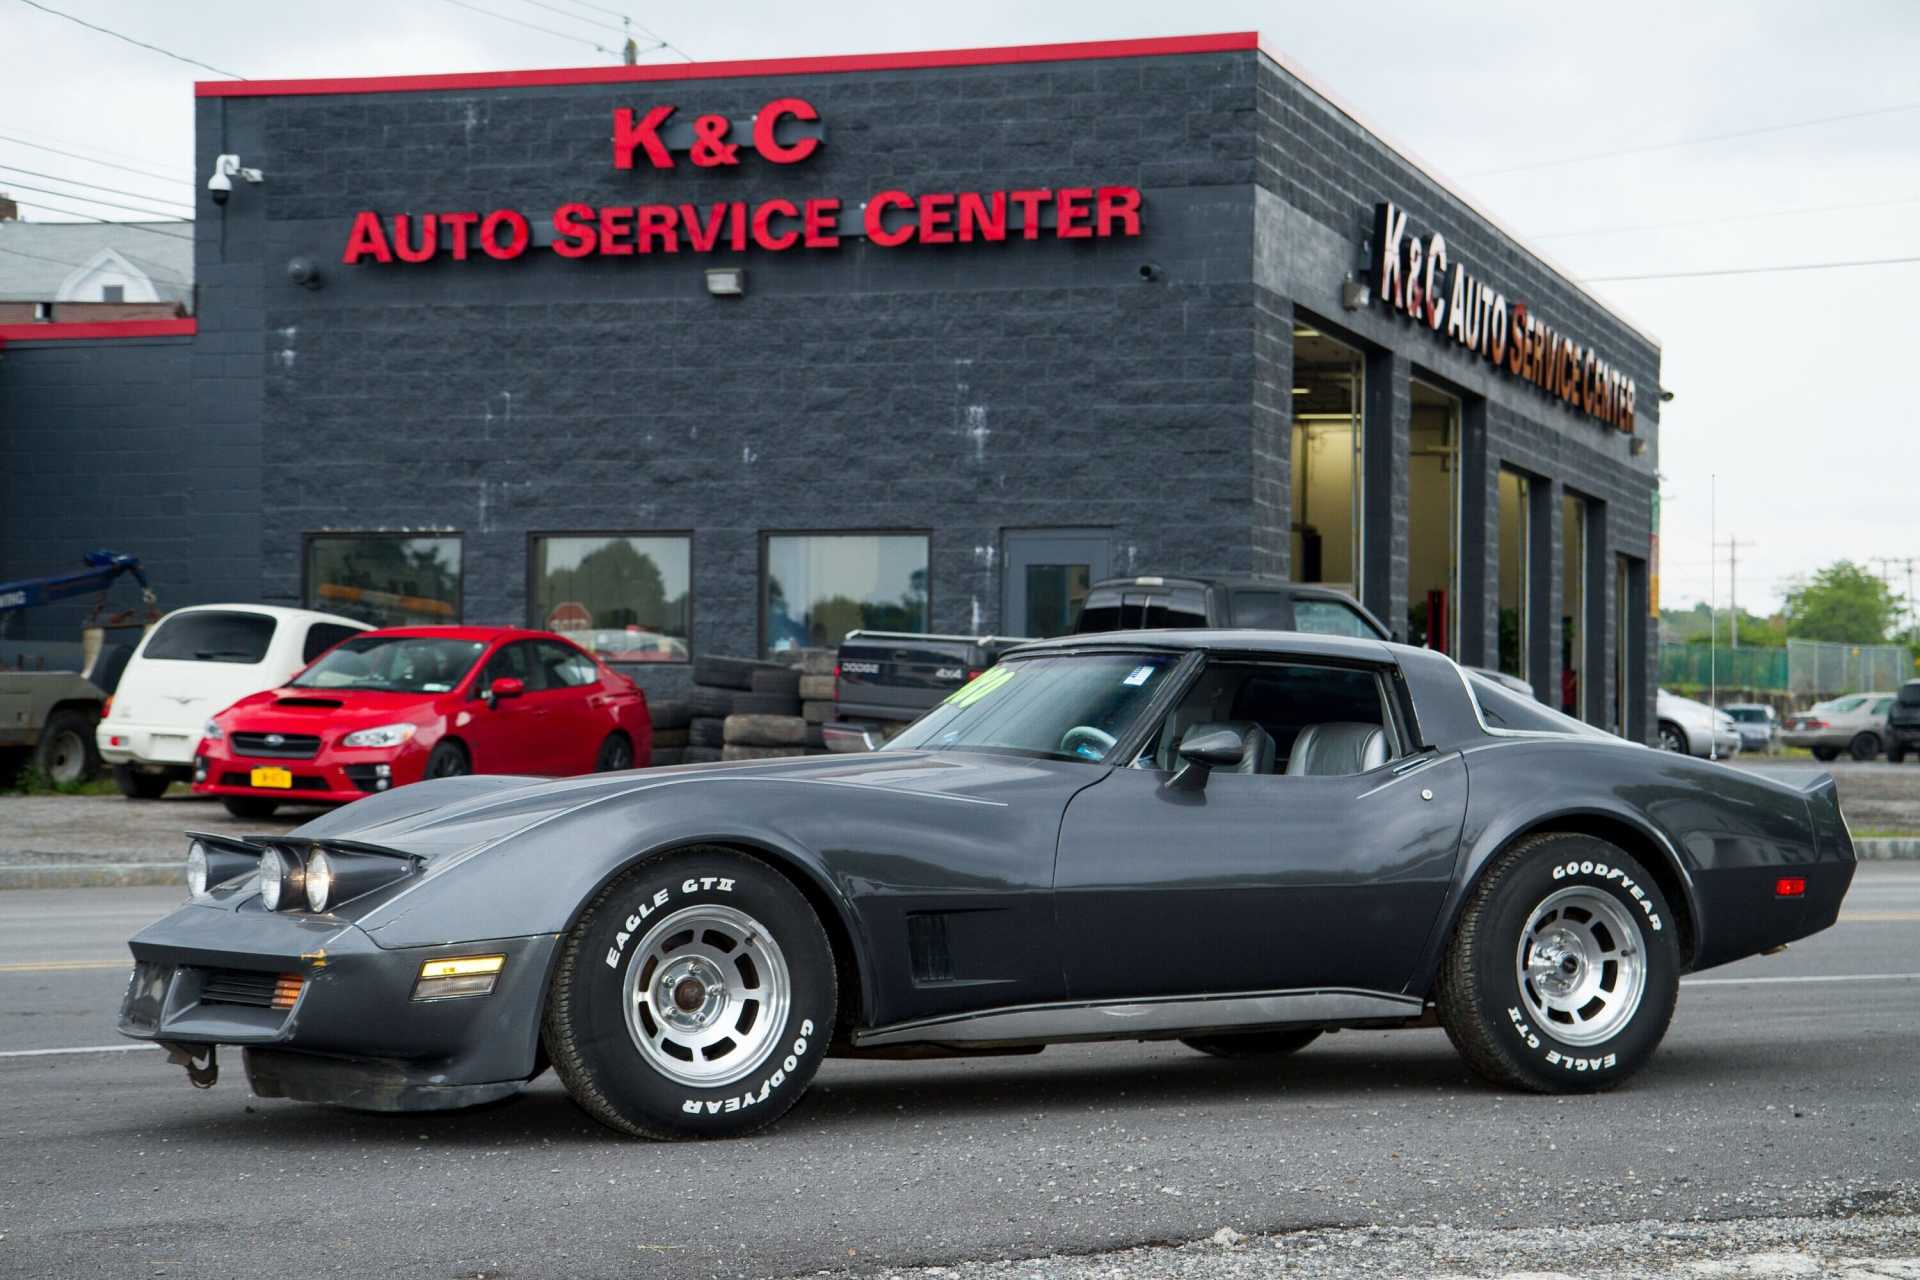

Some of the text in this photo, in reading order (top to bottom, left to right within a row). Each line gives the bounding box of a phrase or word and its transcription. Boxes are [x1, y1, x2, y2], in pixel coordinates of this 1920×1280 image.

[612, 97, 824, 170] K & C
[342, 185, 1142, 265] AUTO SERVICE CENTER
[1447, 262, 1508, 366] AUTO
[1509, 302, 1582, 408] SERVICE
[1583, 346, 1637, 433] CENTER
[842, 662, 880, 674] DODGE
[605, 887, 670, 969] EAGLE
[1552, 860, 1663, 931] GOODYEAR
[681, 1018, 815, 1115] GOODYEAR
[1545, 1049, 1617, 1072] EAGLE
